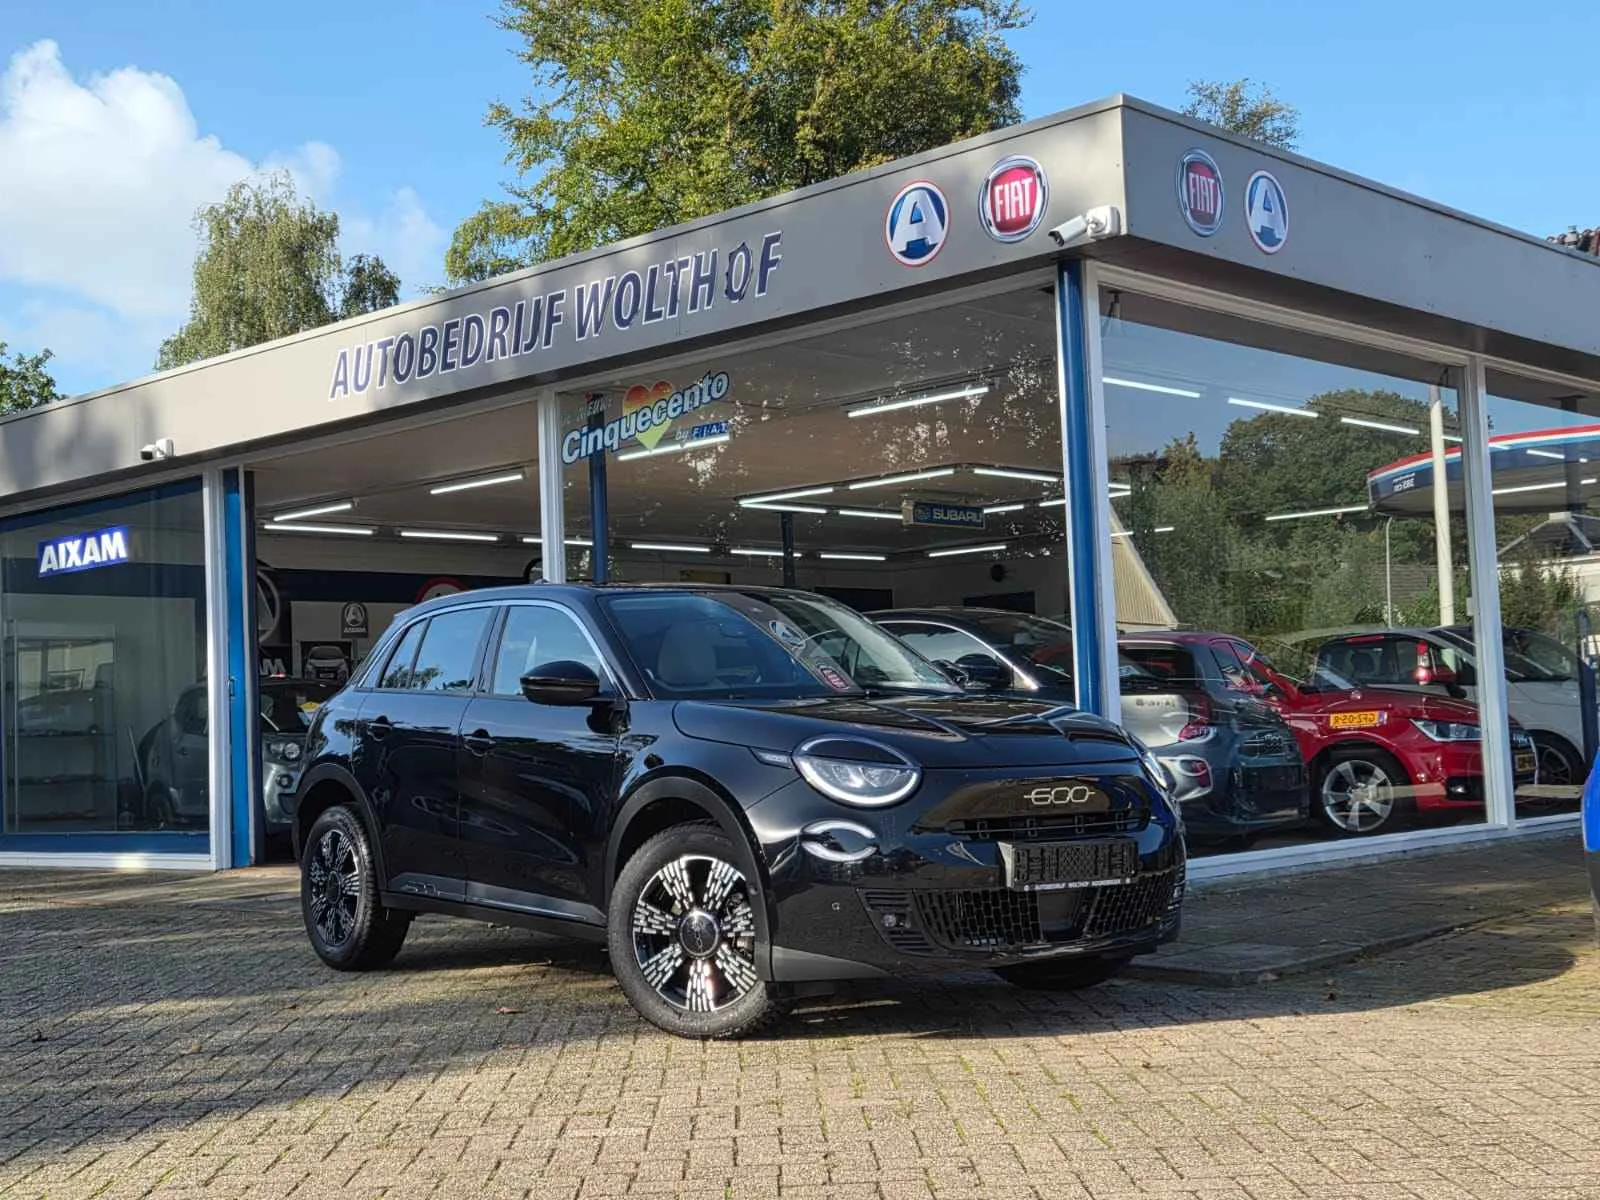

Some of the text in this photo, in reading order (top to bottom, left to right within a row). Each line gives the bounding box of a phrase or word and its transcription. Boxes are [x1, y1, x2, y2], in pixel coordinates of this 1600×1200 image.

[993, 177, 1033, 222] FIAT
[1188, 172, 1215, 214] FIAT
[1249, 178, 1286, 240] A
[892, 188, 943, 253] A
[330, 230, 783, 400] AUTOBEDRIJF WOLTHOF
[561, 371, 730, 464] Cinquecento
[932, 507, 984, 523] SUBARU
[40, 531, 128, 574] AIXAM
[1023, 785, 1096, 805] 600
